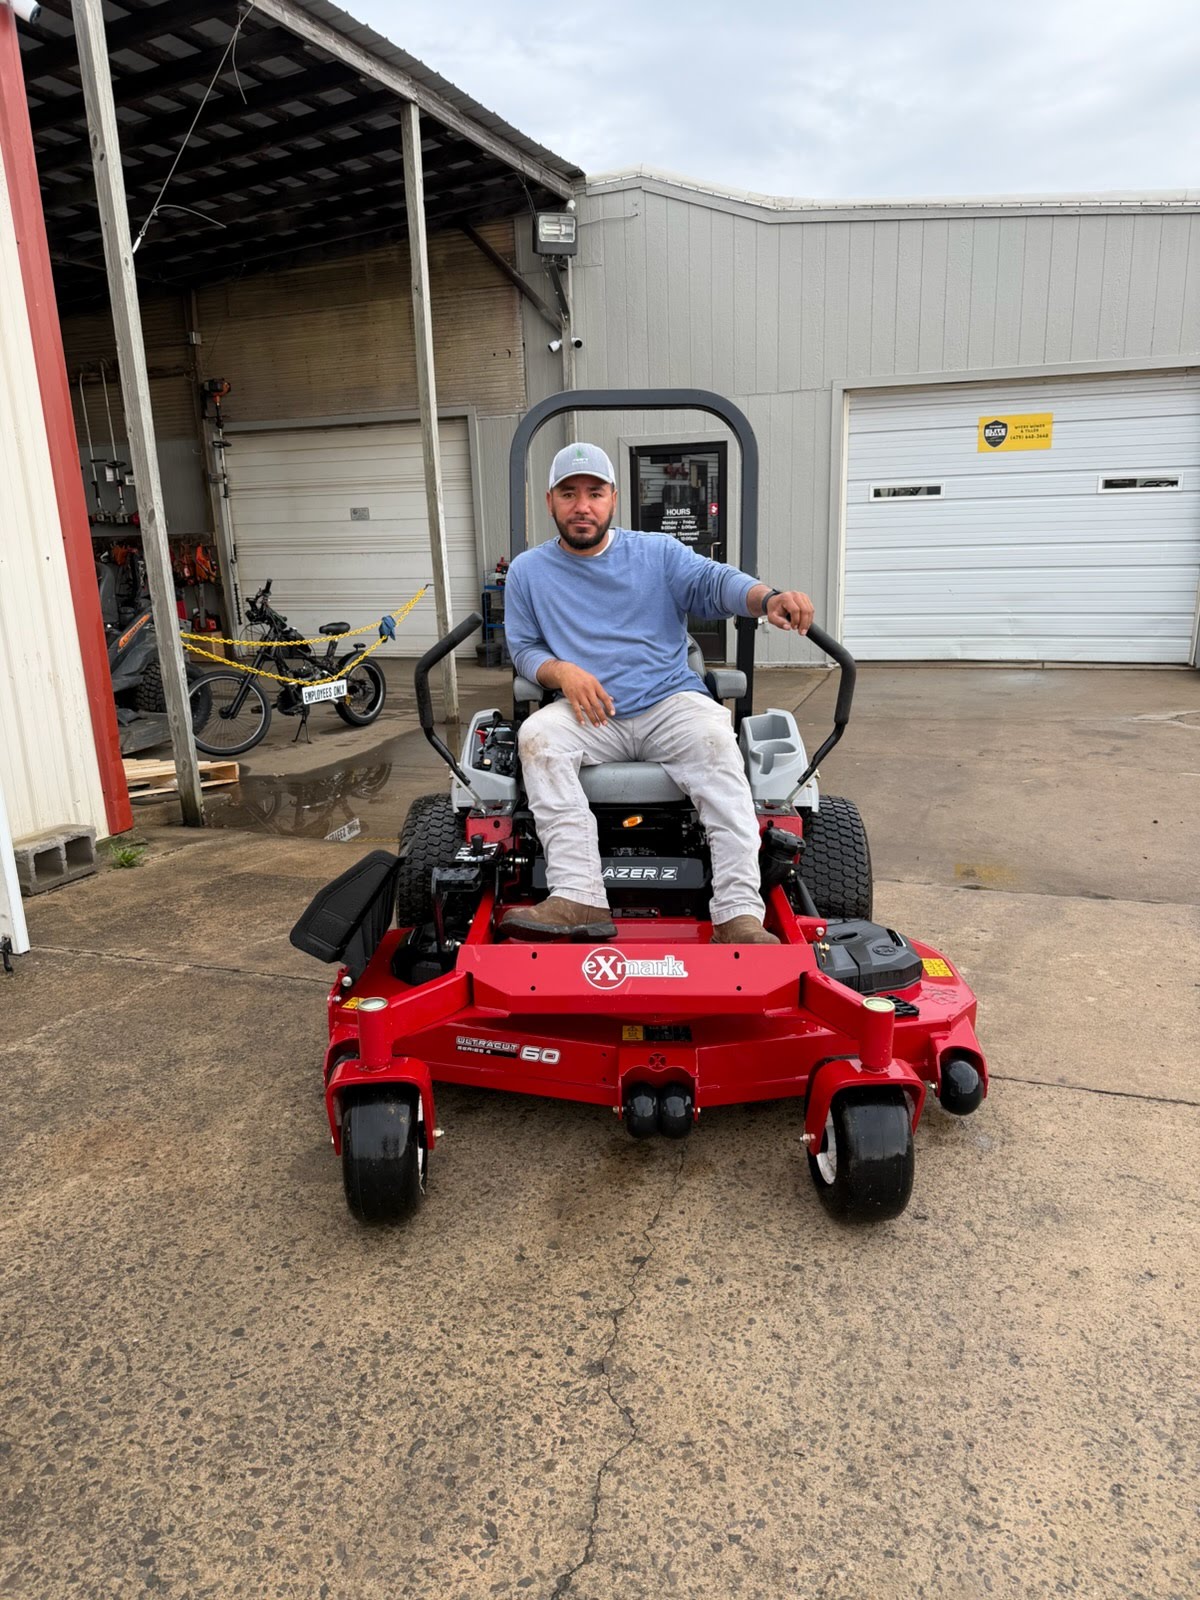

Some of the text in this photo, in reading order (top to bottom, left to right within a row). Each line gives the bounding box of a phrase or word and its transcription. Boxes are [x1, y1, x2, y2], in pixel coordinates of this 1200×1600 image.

[304, 684, 345, 702] EMPLOYEES ONLY
[602, 867, 678, 880] AZER Z
[457, 1037, 518, 1051] ULTRACUT
[457, 1046, 484, 1054] SERIES
[520, 1045, 560, 1064] 60
